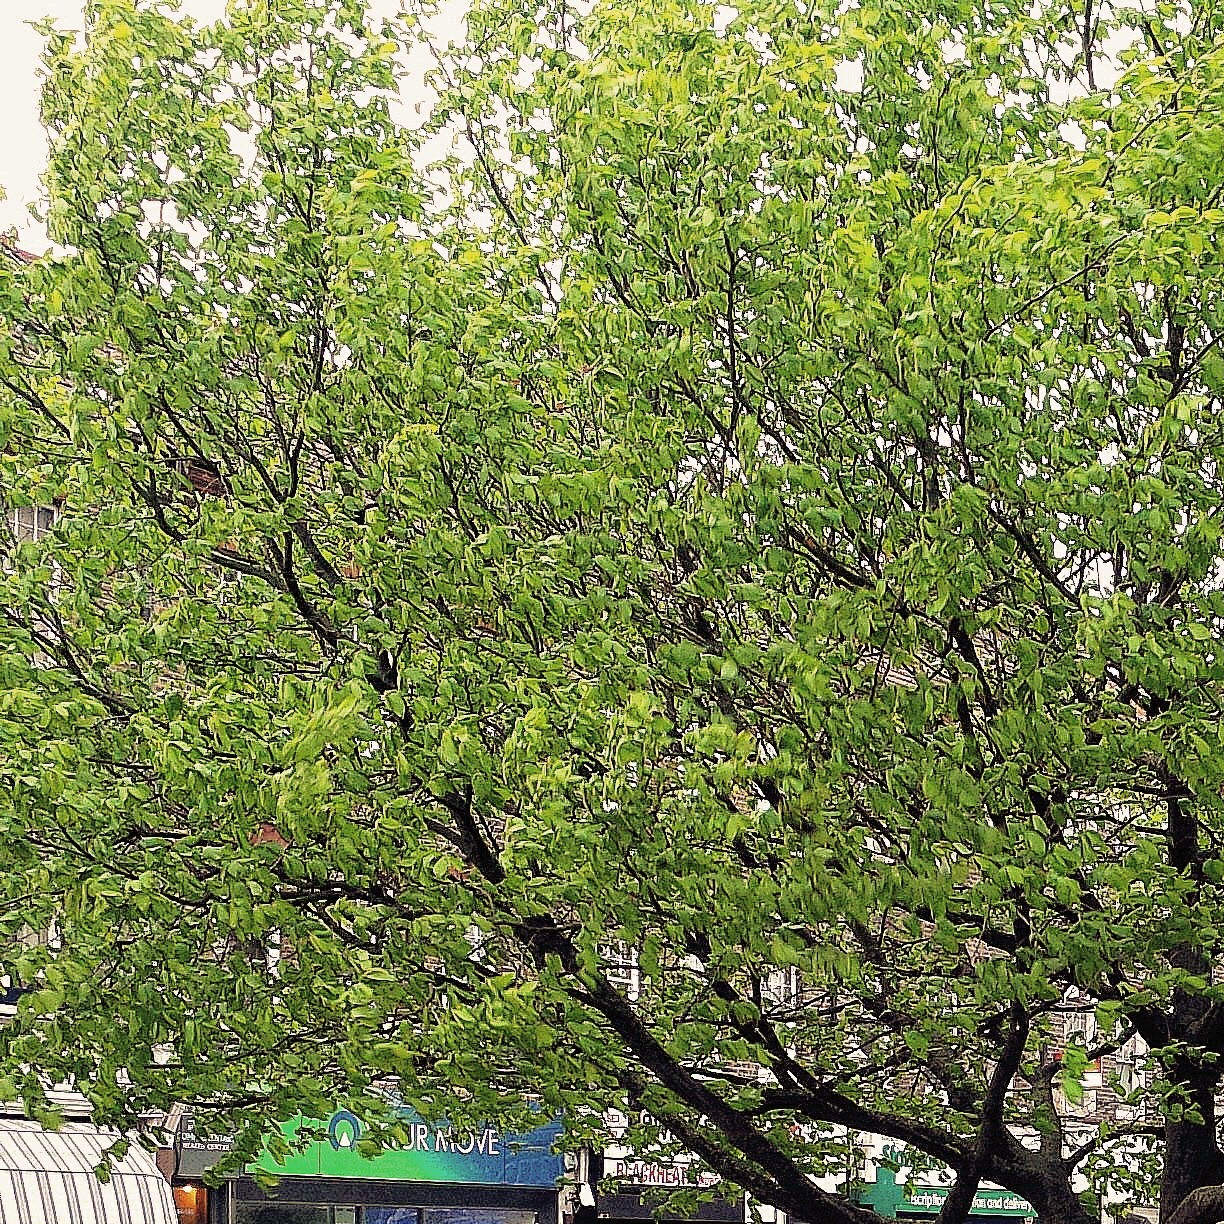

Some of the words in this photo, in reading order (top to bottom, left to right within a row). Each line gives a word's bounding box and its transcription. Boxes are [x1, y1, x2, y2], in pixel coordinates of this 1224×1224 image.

[435, 1127, 499, 1155] MOVE
[617, 1162, 689, 1184] BLACKHEAT
[1003, 1193, 1033, 1213] delivery
